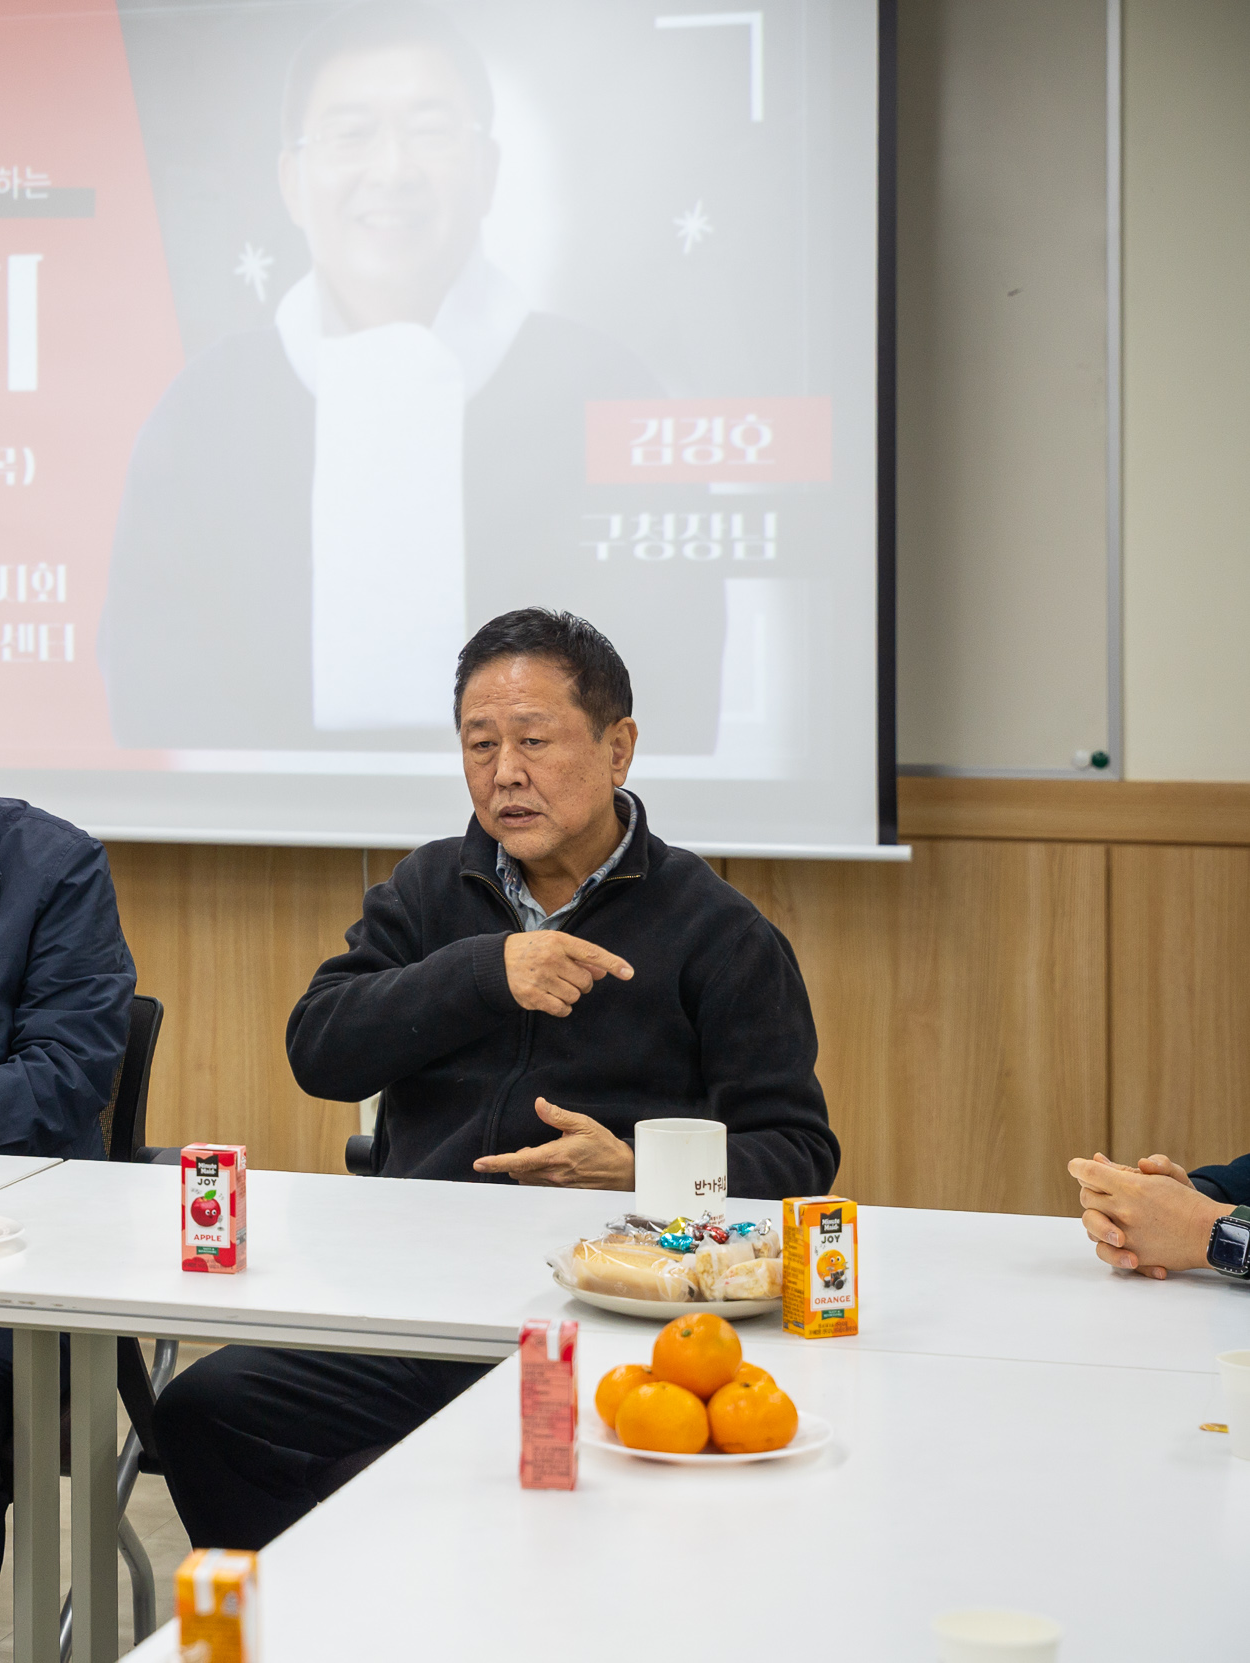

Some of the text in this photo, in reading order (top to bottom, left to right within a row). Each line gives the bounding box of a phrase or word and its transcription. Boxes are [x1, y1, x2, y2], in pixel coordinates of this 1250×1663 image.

[629, 412, 776, 466] 김경호
[579, 511, 779, 562] 구청장님
[197, 1178, 217, 1186] JOY
[193, 1234, 222, 1242] APPLE
[821, 1234, 841, 1244] JOY
[814, 1294, 851, 1305] ORANGE
